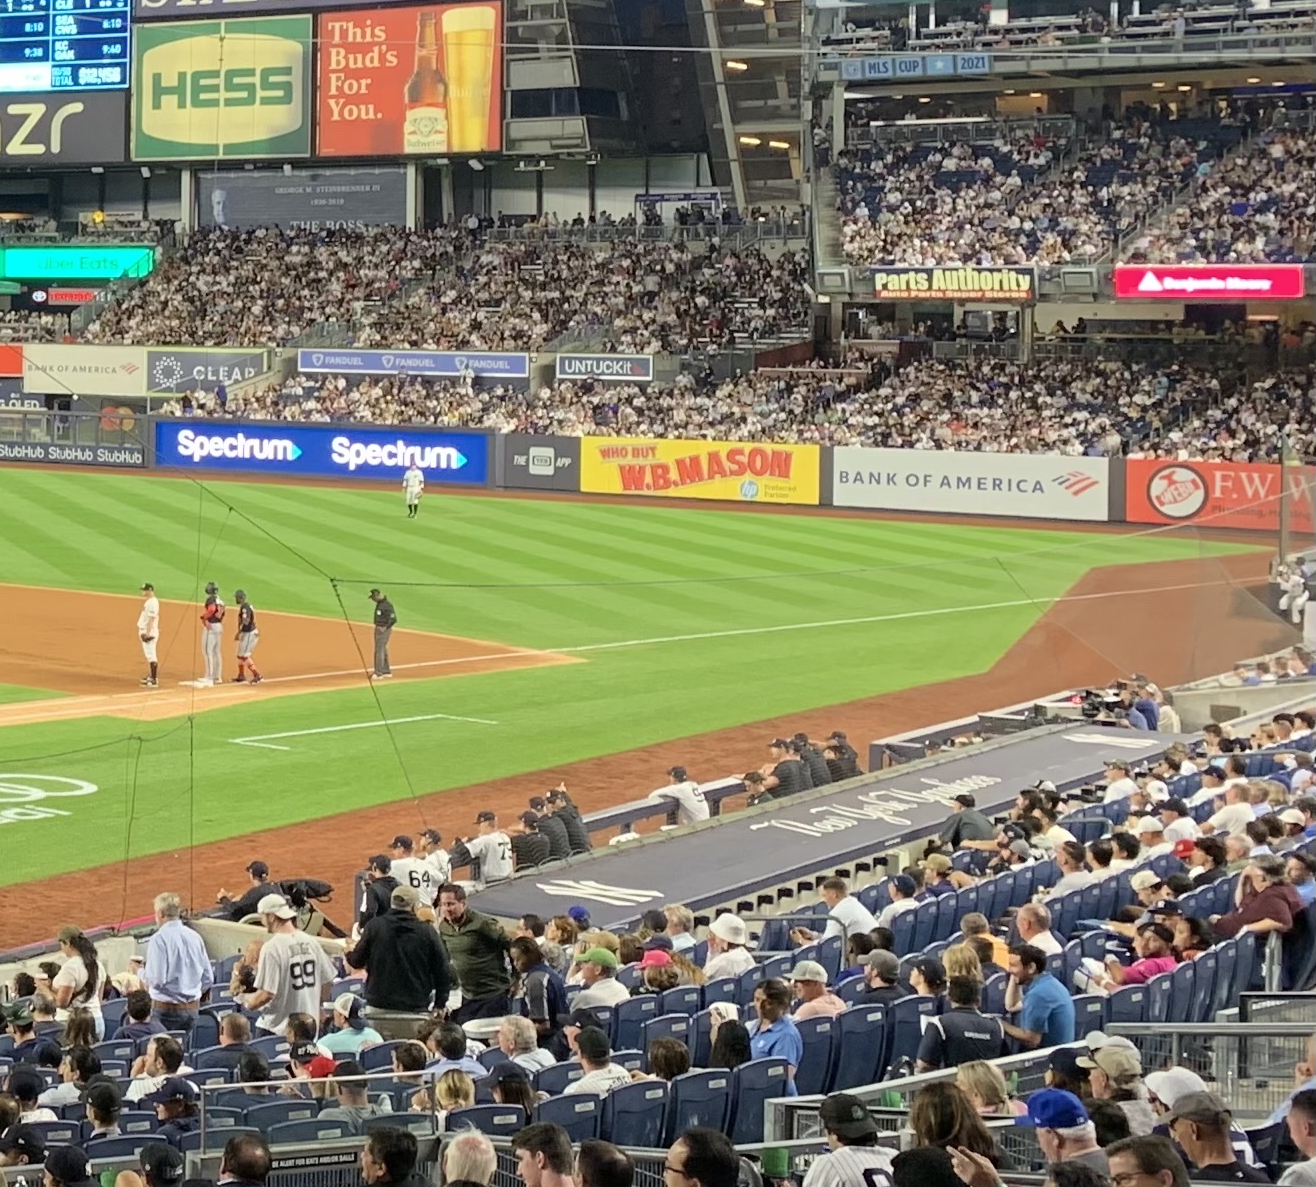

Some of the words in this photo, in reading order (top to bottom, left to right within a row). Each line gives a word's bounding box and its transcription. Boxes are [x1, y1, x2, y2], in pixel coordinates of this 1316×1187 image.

[328, 20, 386, 43] This
[328, 45, 398, 71] Bud's
[869, 61, 889, 74] MLS
[899, 60, 919, 72] CUP
[960, 56, 986, 70] 2021
[152, 66, 293, 110] HESS
[328, 74, 372, 96] For
[328, 99, 383, 121] You.
[290, 220, 319, 233] THE
[326, 220, 364, 233] BOSS
[875, 271, 928, 290] Parts
[932, 268, 1031, 291] Authority
[28, 365, 53, 373] BANK
[55, 365, 70, 374] OF
[73, 366, 118, 374] AMERICA
[325, 356, 364, 366] FANDUEL
[396, 357, 435, 368] FANDUEL
[565, 359, 632, 375] UNTUCKit
[193, 366, 255, 382] CLEAR
[48, 446, 93, 461] StubHub
[97, 448, 142, 464] StubHub
[176, 429, 294, 462] Spectrum
[330, 436, 459, 470] Spectrum
[599, 445, 629, 460] WHO
[632, 446, 657, 459] BUT
[619, 447, 794, 491] W.B.MASON
[839, 470, 898, 488] BANK
[905, 473, 933, 490] OF
[939, 474, 1045, 494] AMERICA
[409, 870, 430, 888] 64
[290, 960, 316, 991] 99
